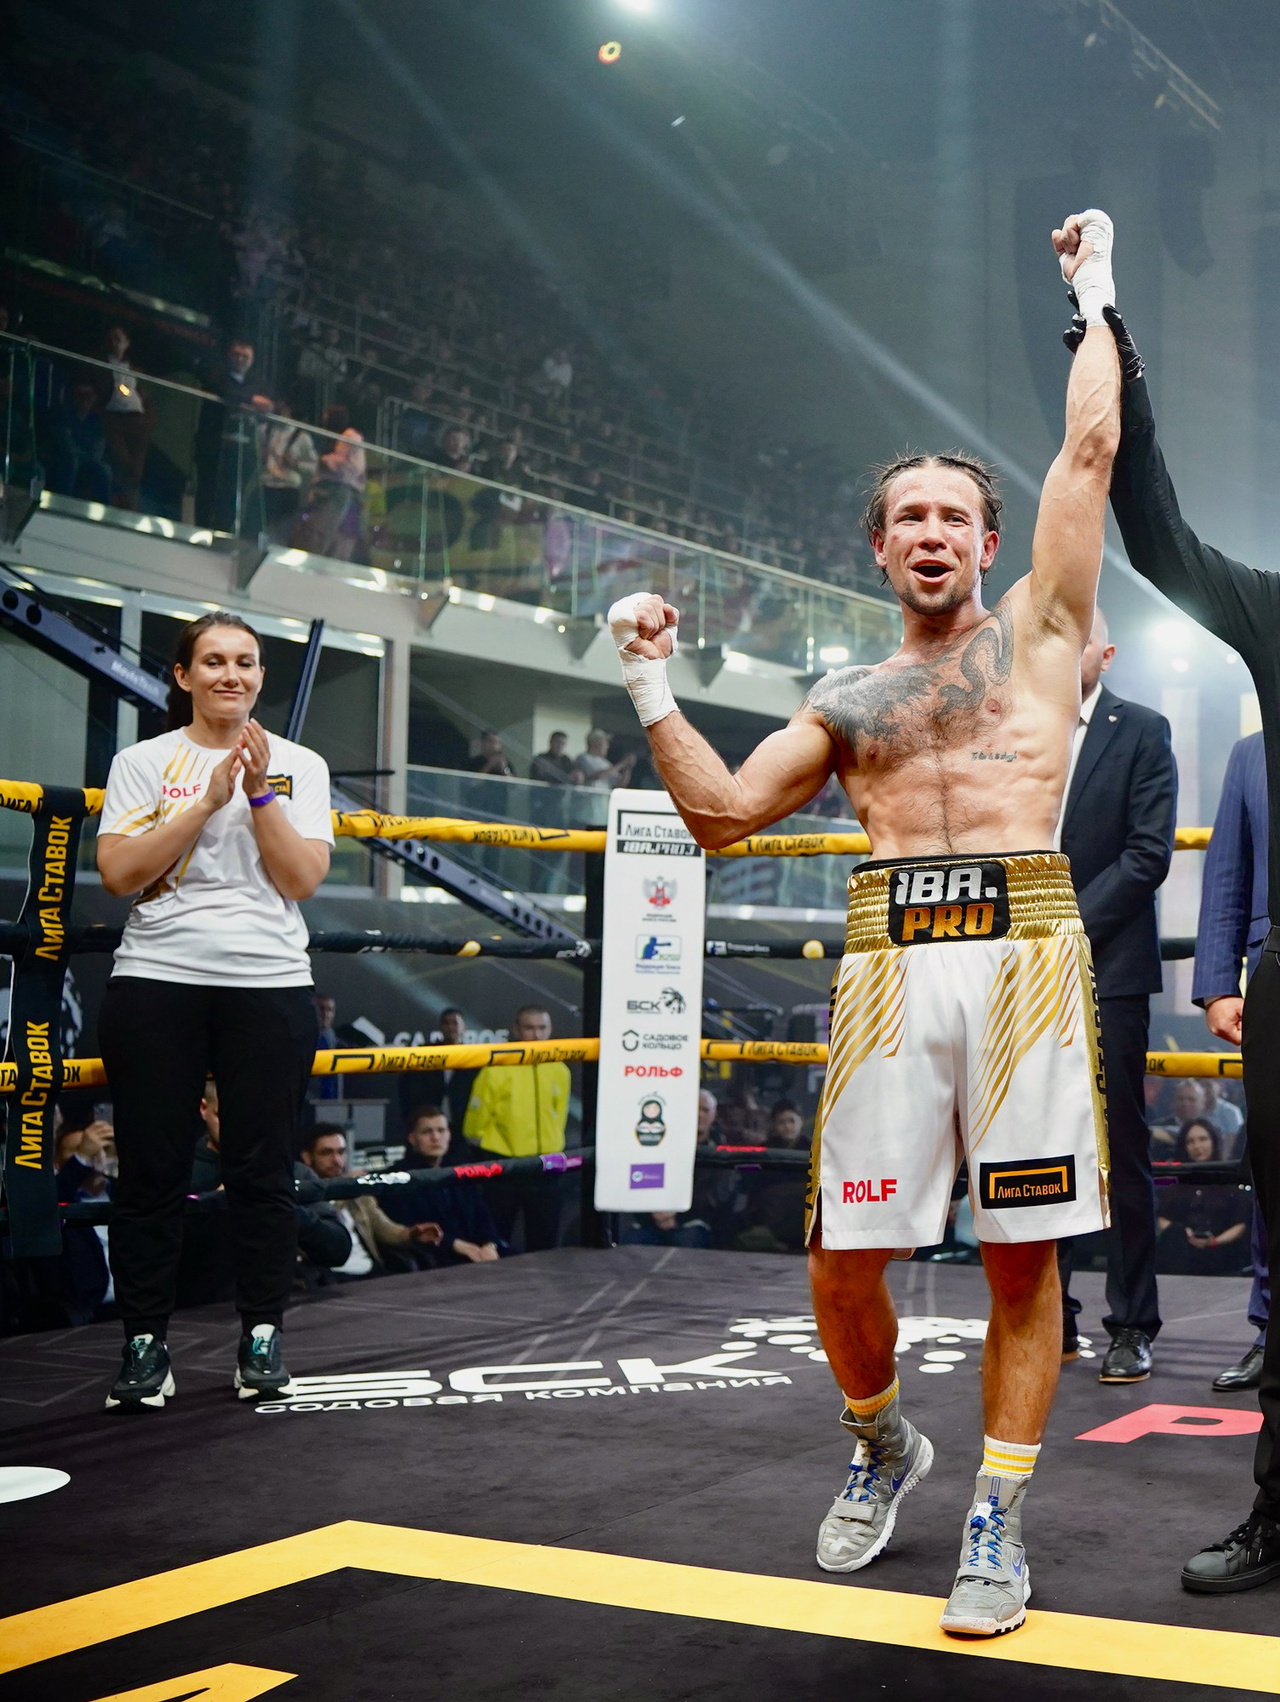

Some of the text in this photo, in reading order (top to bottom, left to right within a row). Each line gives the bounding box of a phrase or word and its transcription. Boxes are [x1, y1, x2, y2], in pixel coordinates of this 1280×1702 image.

[625, 824, 652, 838] ЛИГА
[35, 815, 73, 960] ЛИГА СТАВОК
[902, 903, 995, 941] PRO
[627, 1000, 661, 1011] БСК
[624, 1065, 683, 1077] РОЛЬФ
[15, 1021, 53, 1169] ЛИГА СТАВОК
[842, 1179, 897, 1203] ROLF
[997, 1183, 1062, 1199] ЛИГА СТАВОК
[524, 1375, 793, 1401] КОМПАНИЯ
